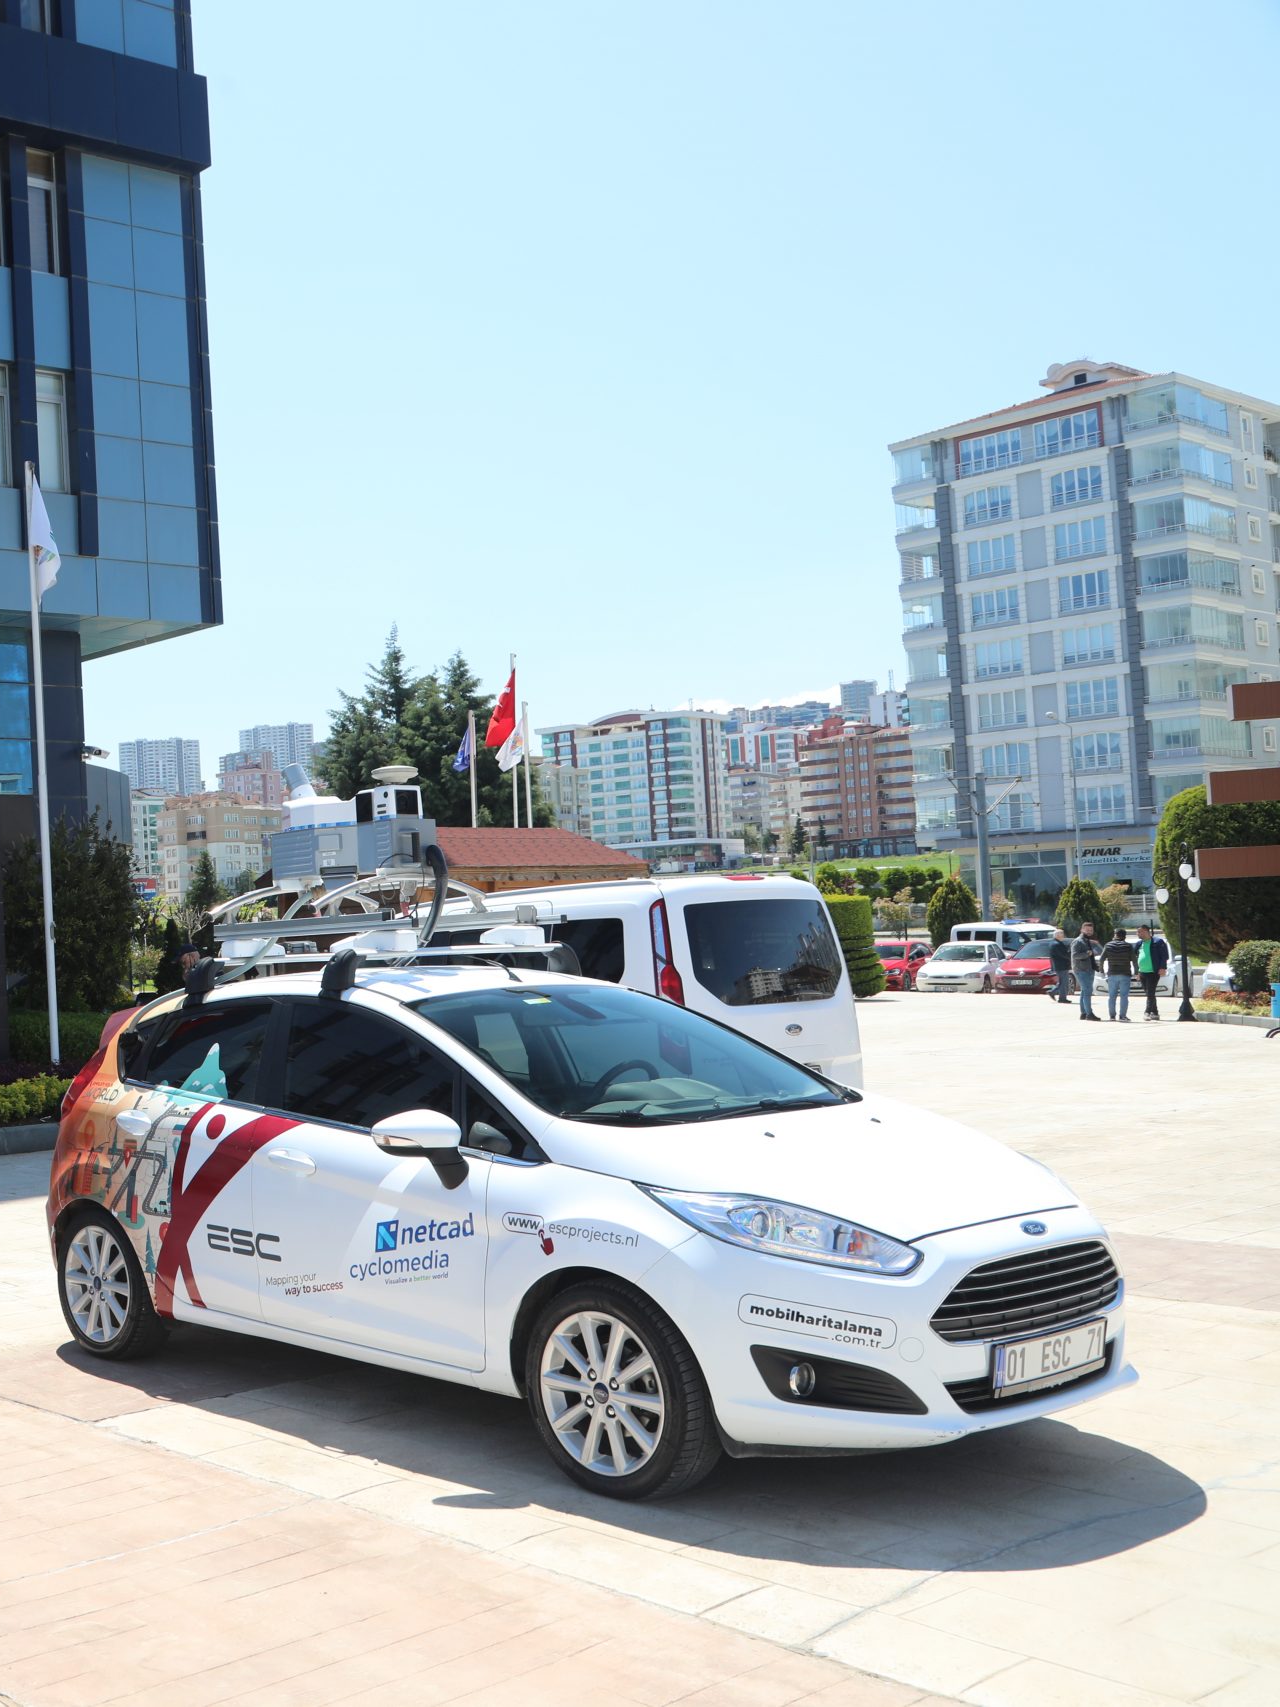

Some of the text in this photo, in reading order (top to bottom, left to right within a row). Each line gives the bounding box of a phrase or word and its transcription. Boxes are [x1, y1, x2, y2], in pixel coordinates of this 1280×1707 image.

[207, 1223, 282, 1262] ESC
[401, 1212, 475, 1245] netcad
[507, 1216, 639, 1248] www escprojects.nl
[265, 1272, 317, 1287] Mapping your
[349, 1249, 450, 1282] cyclomedia
[384, 1277, 408, 1285] Visualize
[413, 1274, 431, 1282] better
[432, 1271, 449, 1280] world
[284, 1281, 344, 1297] way to success
[749, 1304, 883, 1337] mobilharitalama
[831, 1334, 882, 1349] .com.tr
[1007, 1326, 1103, 1381] 01 ESC 71
